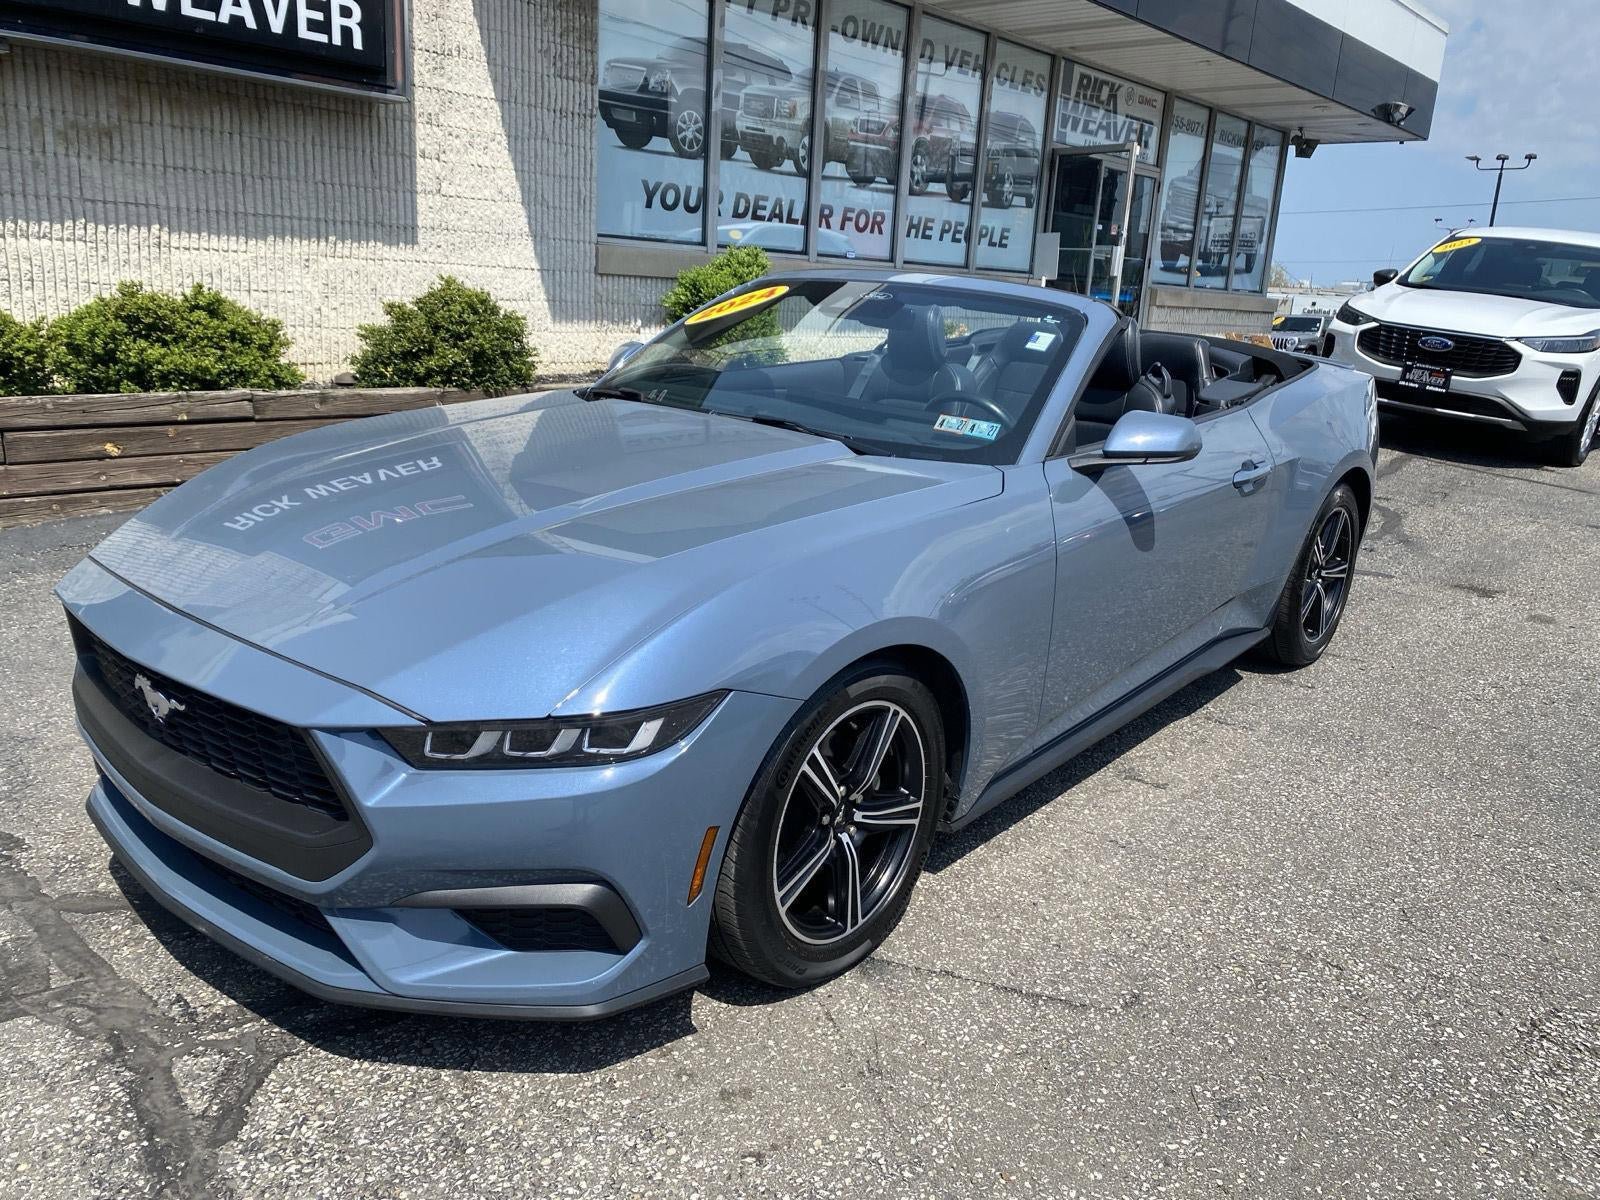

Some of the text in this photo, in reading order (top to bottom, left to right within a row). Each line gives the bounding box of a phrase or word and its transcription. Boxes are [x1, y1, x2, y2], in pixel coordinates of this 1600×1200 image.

[127, 0, 363, 50] AVER
[770, 0, 1046, 97] PR-OWND VEHCLES
[1074, 73, 1124, 112] RICK
[1137, 94, 1157, 109] GMC
[1171, 114, 1205, 136] 55-8071
[840, 206, 886, 235] FOR
[905, 214, 936, 240] HE
[700, 287, 778, 319] 2024
[1405, 371, 1446, 386] WEAVER
[957, 419, 968, 431] 27
[987, 425, 998, 437] 27
